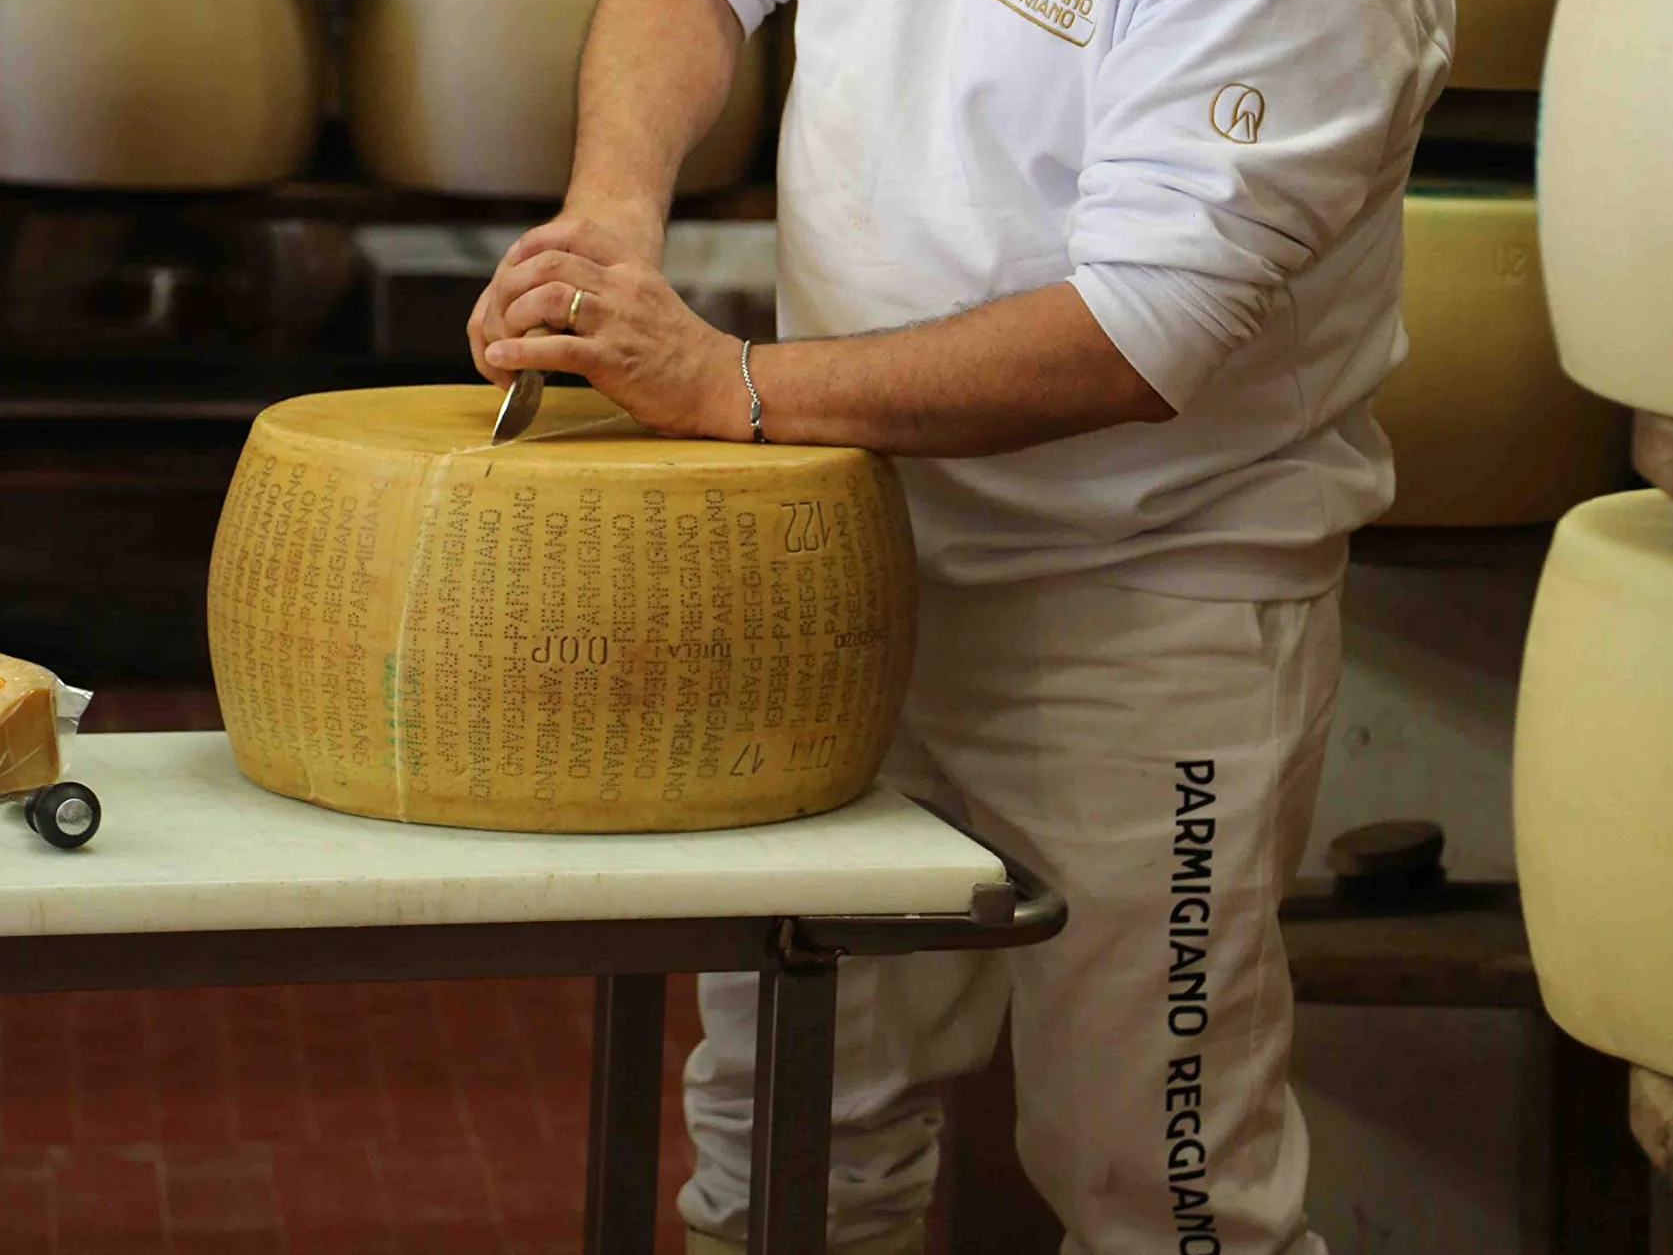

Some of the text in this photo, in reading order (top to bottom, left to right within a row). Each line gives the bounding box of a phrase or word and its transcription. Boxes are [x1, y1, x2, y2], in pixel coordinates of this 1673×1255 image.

[261, 462, 309, 616] PARMIGIANO
[281, 489, 318, 617] REGGIANO
[300, 466, 345, 622] PARMIGIANO
[323, 495, 360, 625] REGGIANO
[471, 508, 503, 637] REGGIANO
[504, 486, 538, 639] PARMIGIANO
[612, 513, 637, 643] REGGIANO
[645, 488, 671, 643] PARMIGIANO
[677, 513, 704, 645] REGGIANO
[705, 488, 734, 644] PARMIGIANO
[737, 511, 766, 641] REGGIANO
[781, 500, 833, 554] 122
[770, 560, 793, 641] PARMI
[797, 560, 819, 639] REGGI
[468, 653, 494, 800] PARMIGIANO
[502, 656, 528, 778] REGGIANO
[601, 658, 635, 802] PARMIGIANO
[635, 660, 669, 779] REGGIANO
[662, 659, 701, 802] PARMIGIANO
[697, 660, 733, 779] REGGIANO
[734, 656, 764, 733] PARMI
[764, 655, 792, 730] REGGI
[730, 742, 767, 778] 17
[1165, 759, 1222, 1255] PARMIGIANO REGGIANO
